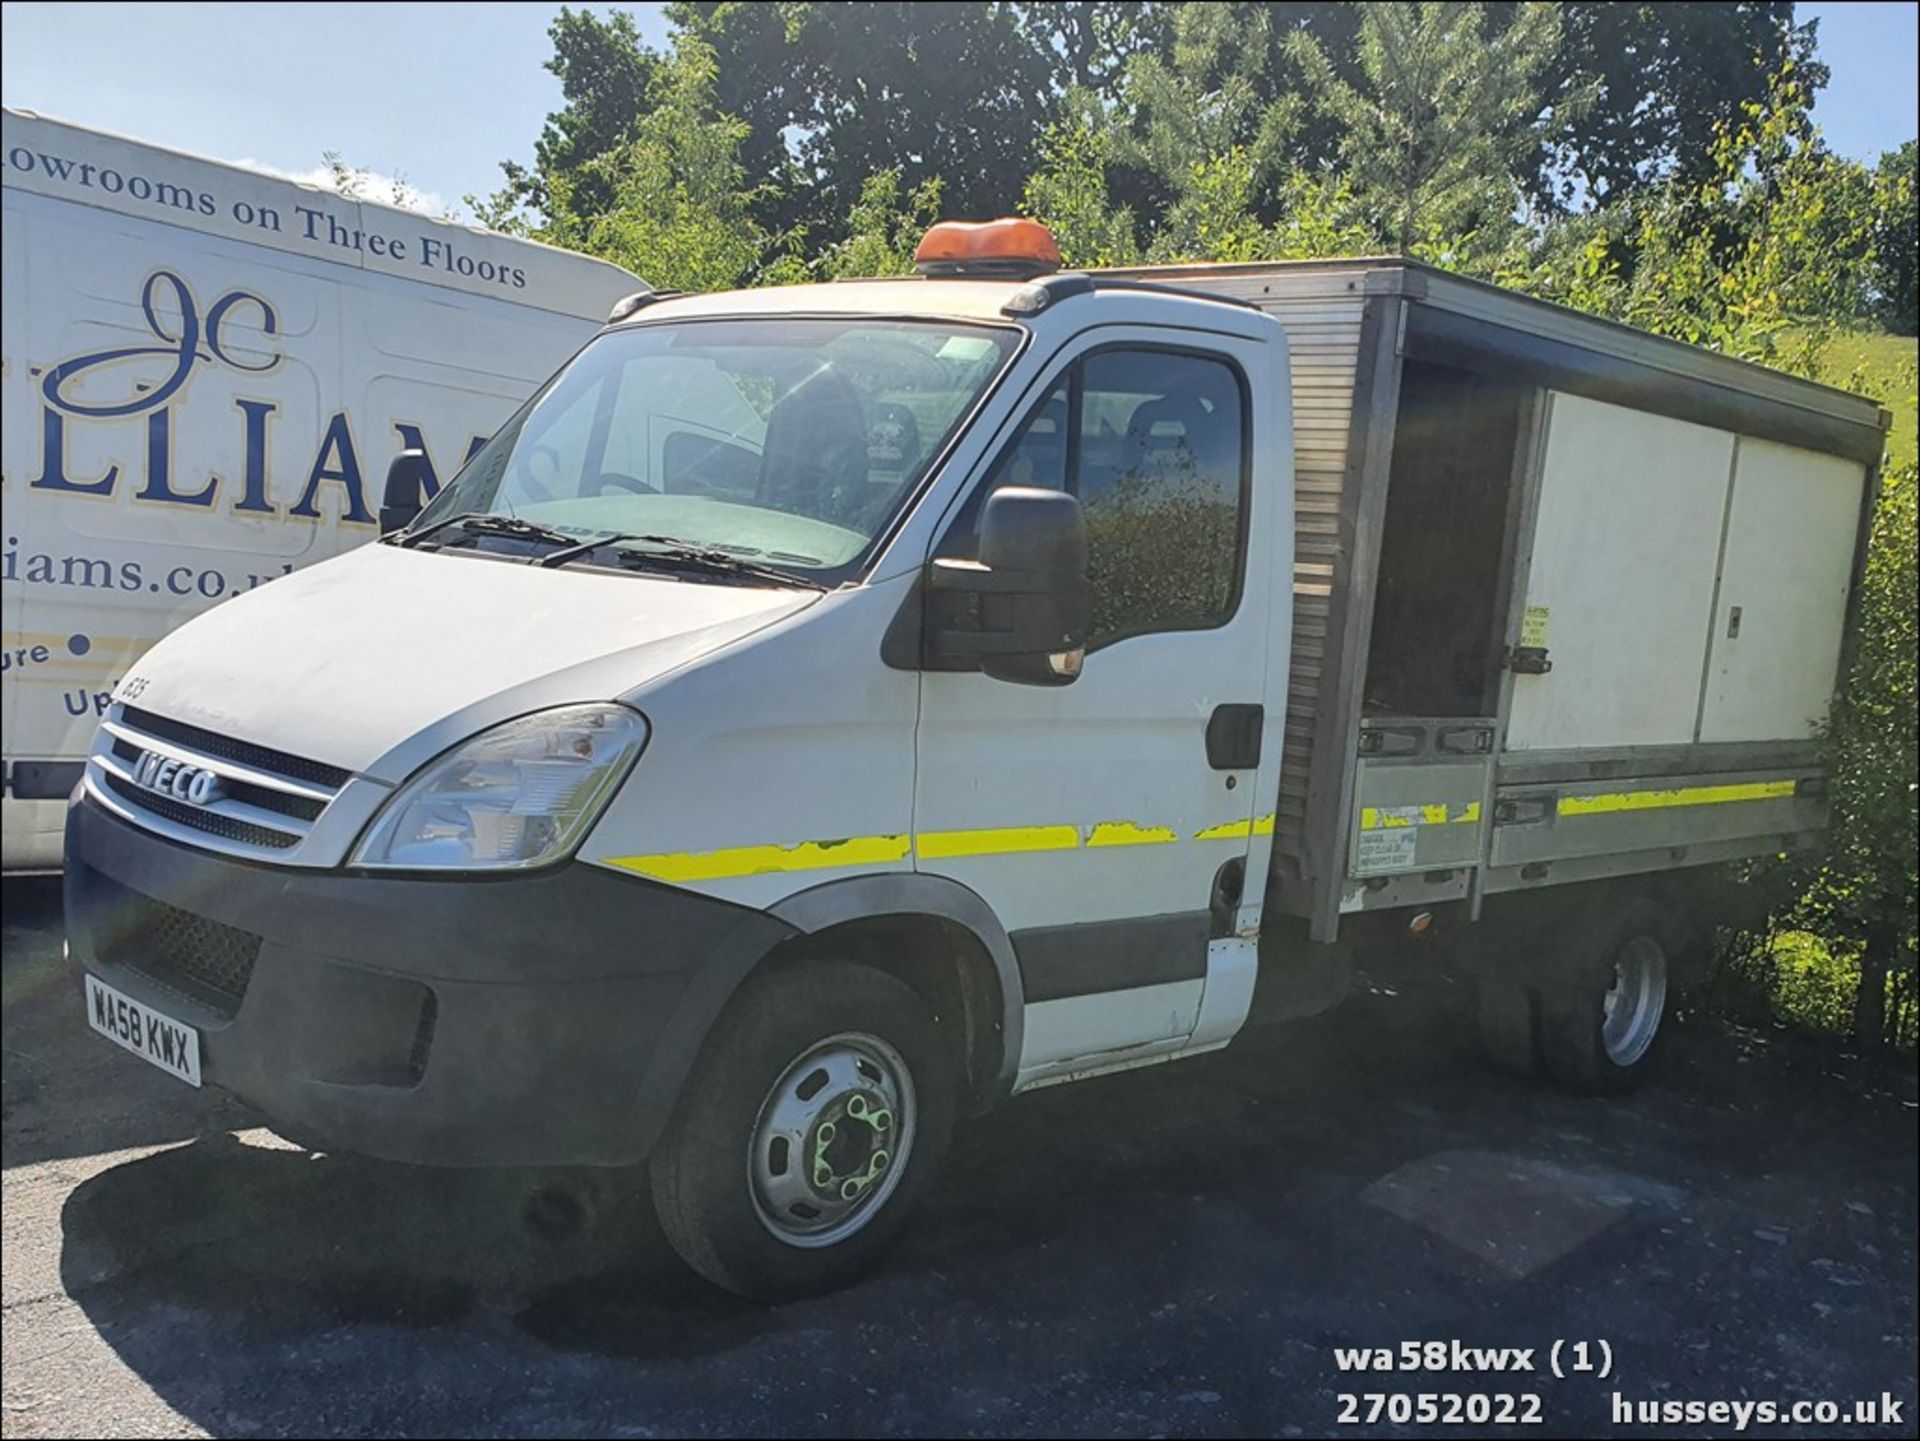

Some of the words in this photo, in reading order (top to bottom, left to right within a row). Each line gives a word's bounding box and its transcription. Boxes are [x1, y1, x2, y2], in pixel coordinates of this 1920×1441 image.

[2, 147, 216, 216] owrooms
[232, 200, 281, 231] on
[295, 204, 406, 261] Three
[419, 236, 528, 289] Floors
[2, 537, 293, 598] iams.co.
[64, 679, 119, 717] Up
[133, 750, 217, 804] IVECO
[93, 985, 143, 1049] WA58
[146, 1014, 190, 1075] KWX
